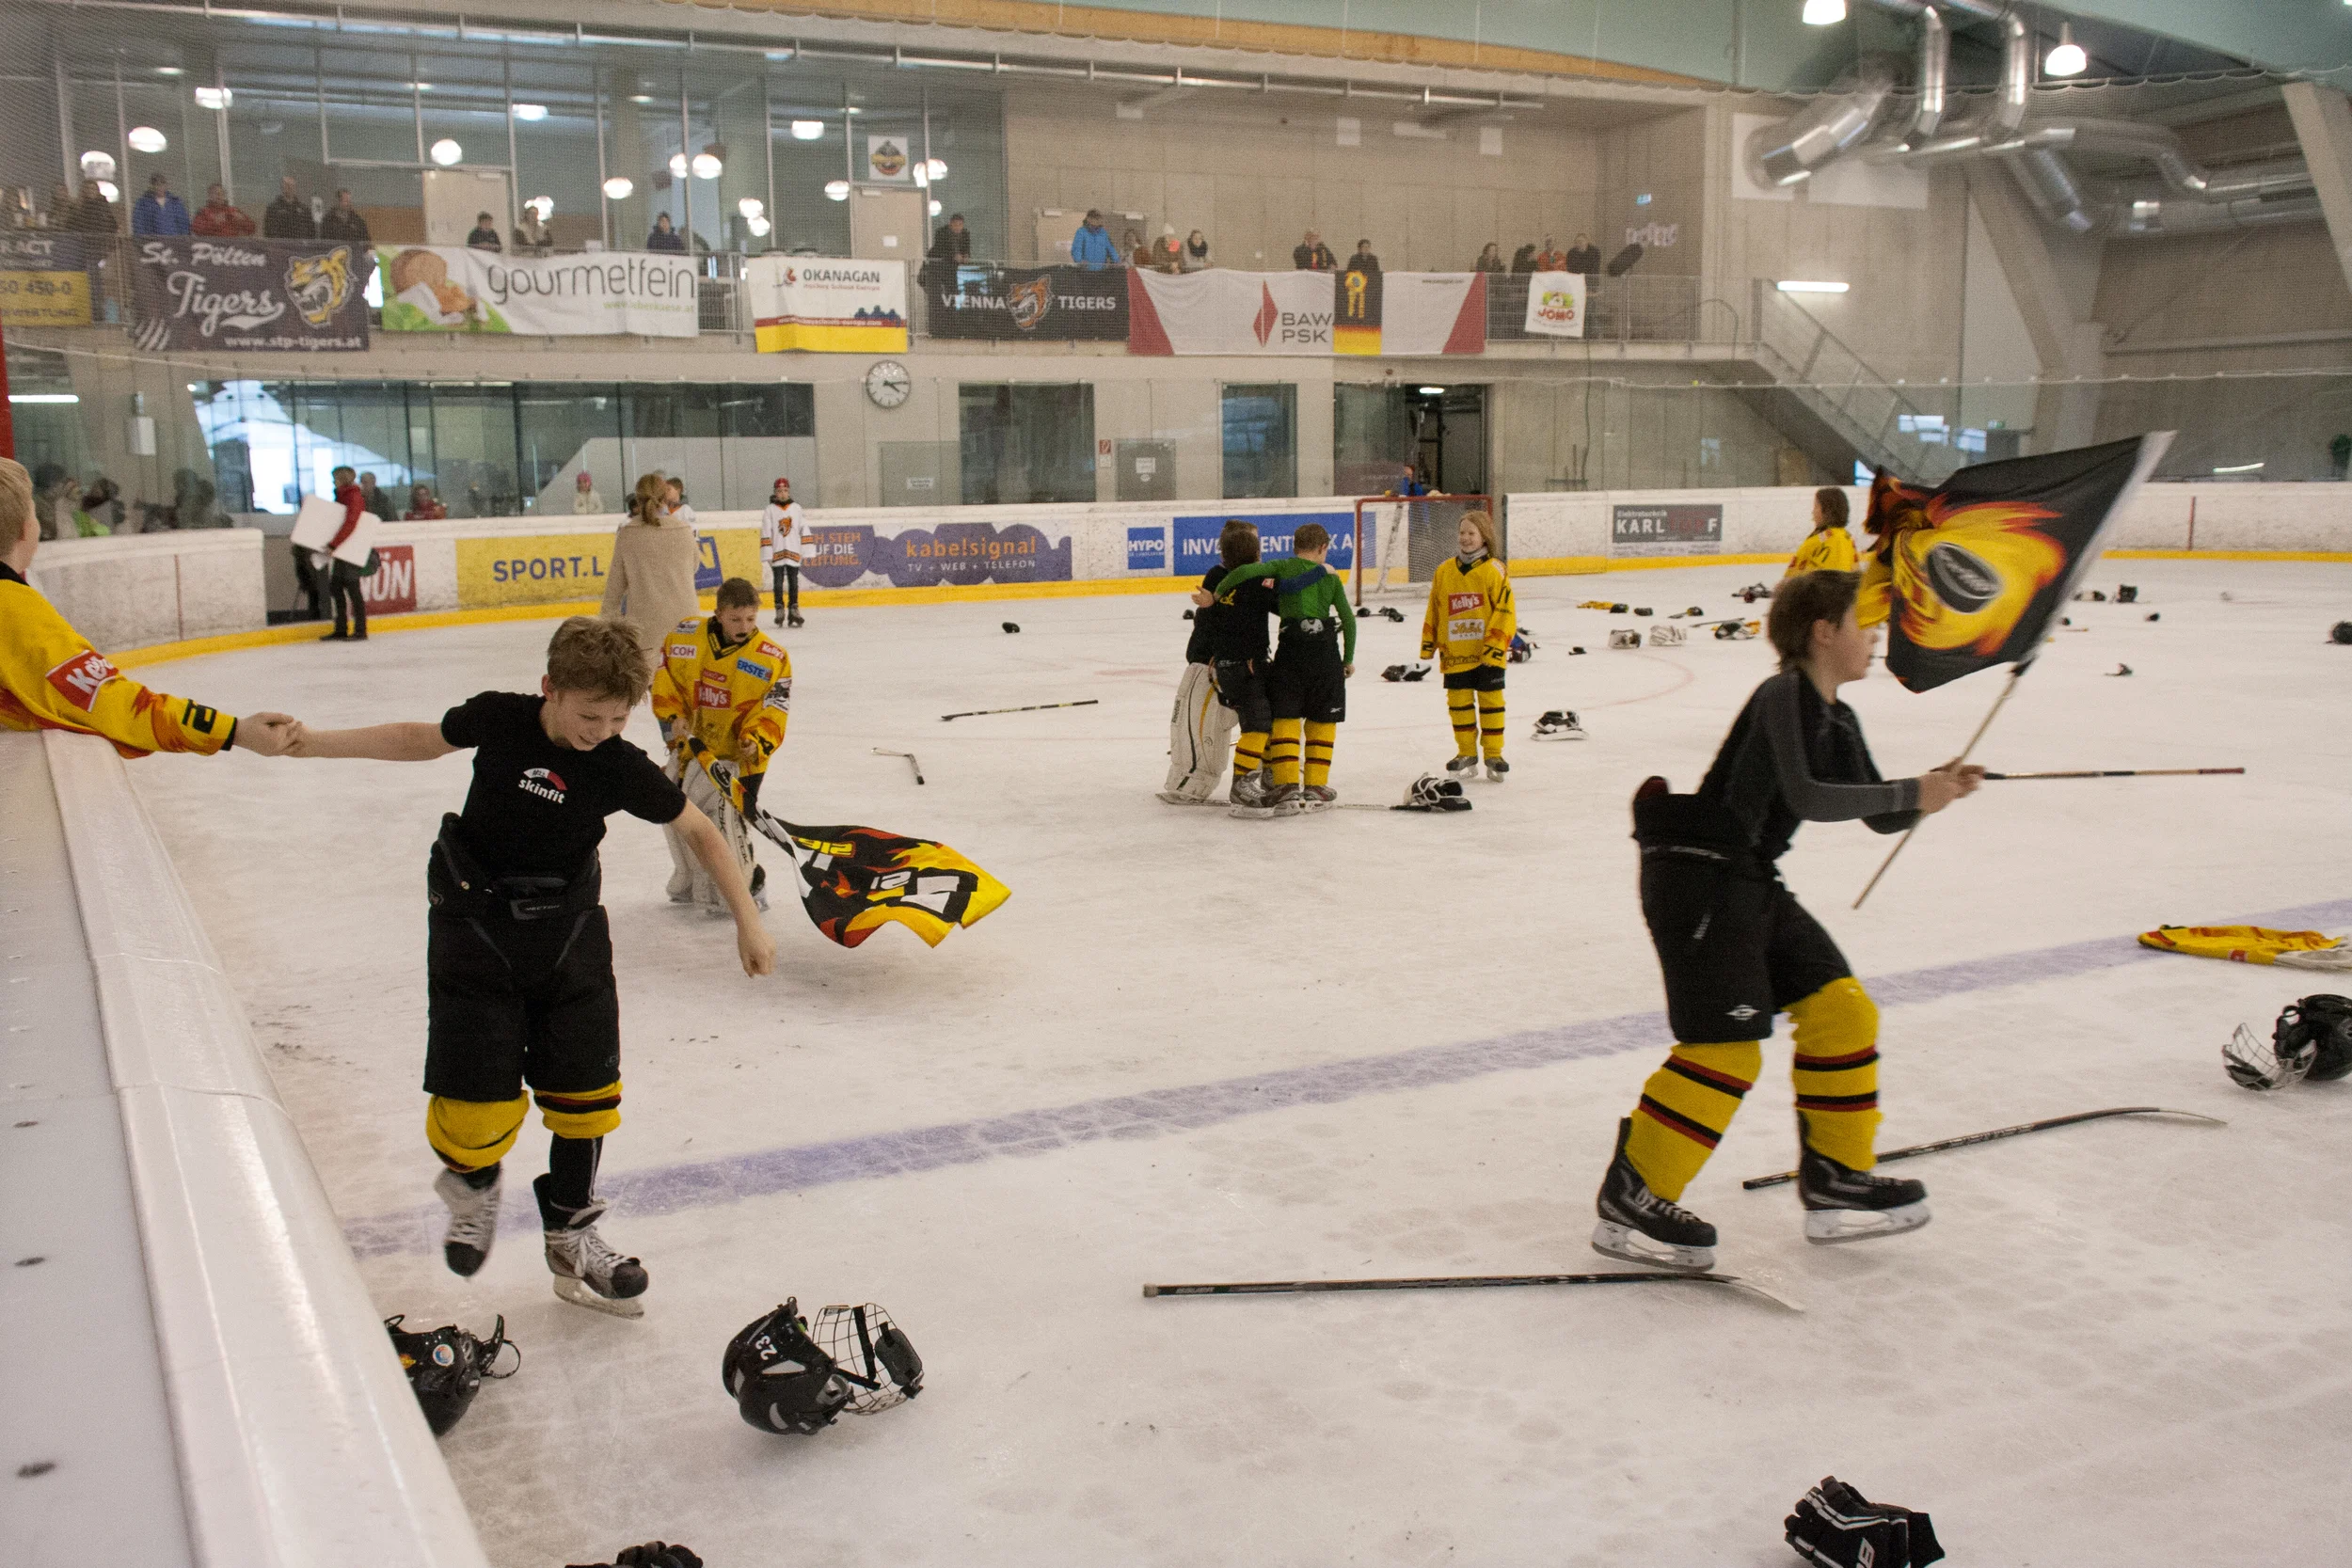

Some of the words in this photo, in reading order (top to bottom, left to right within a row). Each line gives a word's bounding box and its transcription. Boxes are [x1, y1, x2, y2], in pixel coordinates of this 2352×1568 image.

[140, 242, 179, 264] St.
[191, 243, 267, 266] Pölten
[487, 257, 694, 305] gourmetfein
[803, 268, 881, 283] OKANAGAN
[167, 271, 283, 337] Tigers
[942, 293, 1007, 309] VIENNA
[1057, 295, 1116, 309] TIGERS
[1281, 329, 1328, 343] PSK
[1615, 518, 1665, 534] KARL
[829, 532, 861, 544] STEH
[1128, 539, 1165, 552] HYPO
[834, 543, 855, 555] DIE
[908, 563, 922, 572] TV
[941, 562, 966, 571] WEB
[984, 560, 1036, 569] TELEFON
[1452, 594, 1480, 610] Kelly's
[1483, 644, 1504, 661] 72
[737, 659, 767, 677] ERSTE
[518, 779, 564, 804] skinfit
[755, 1335, 778, 1361] 23
